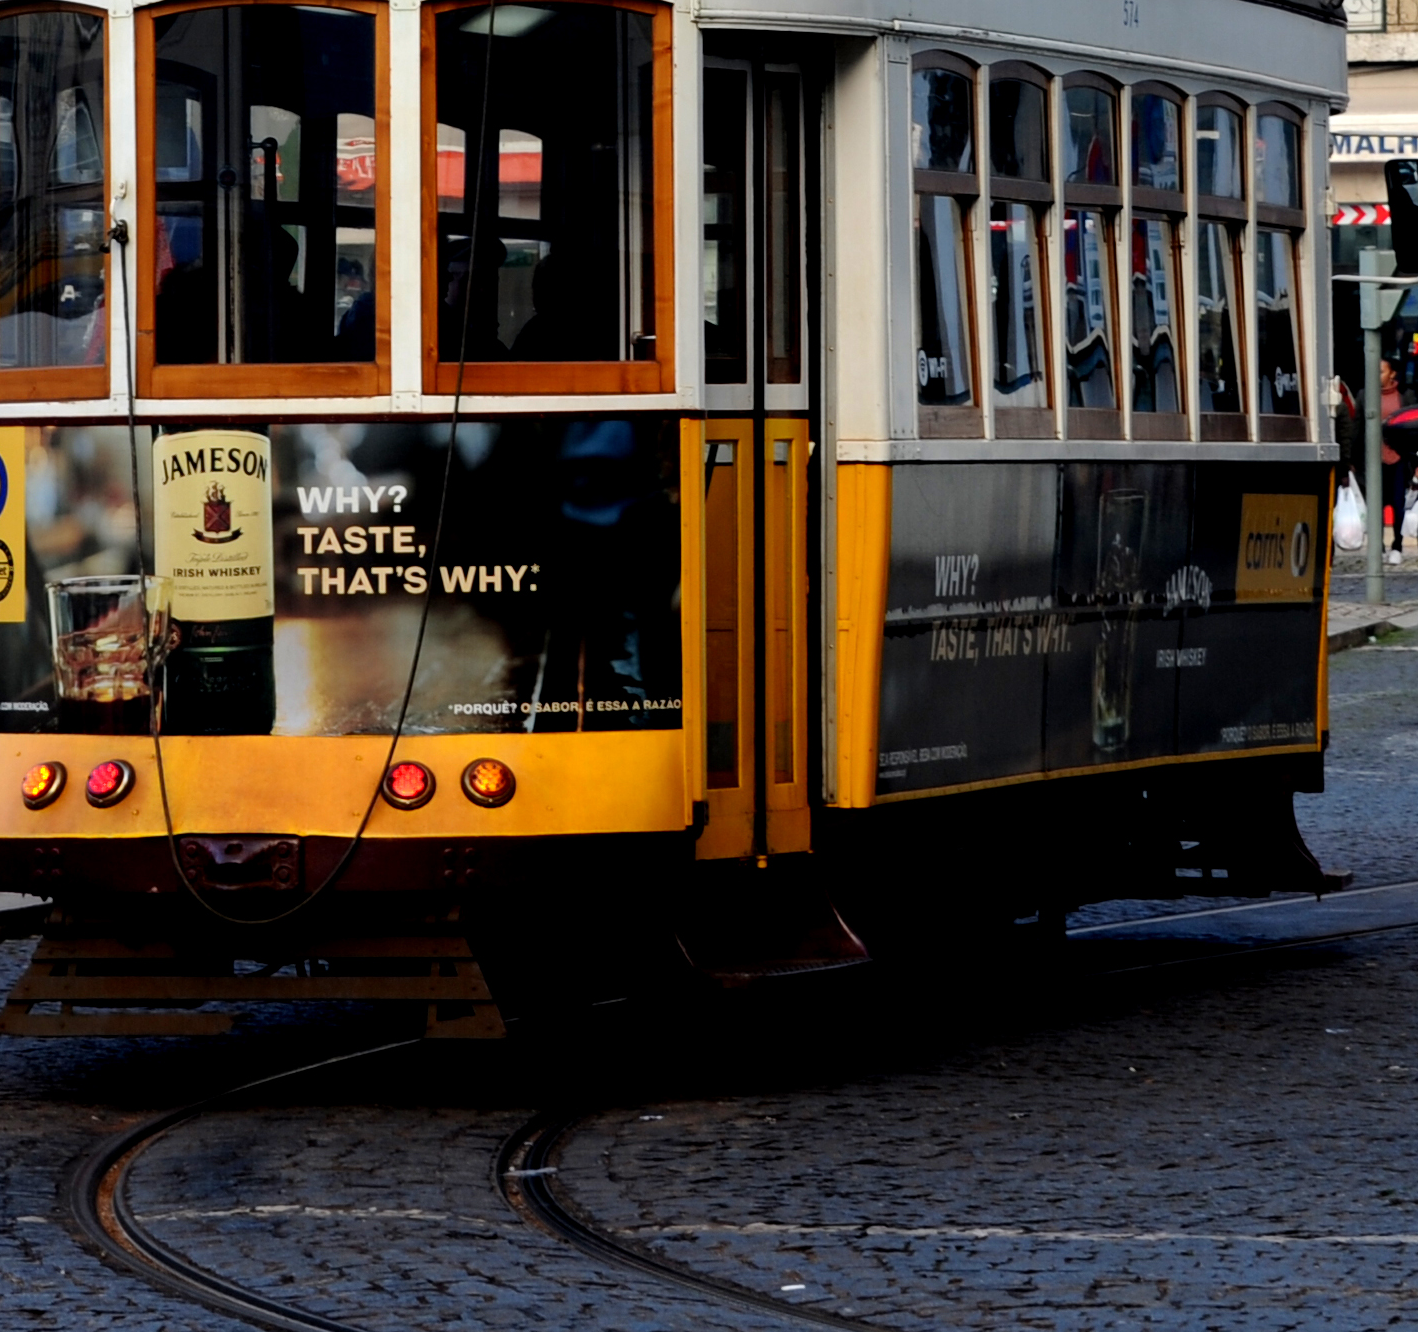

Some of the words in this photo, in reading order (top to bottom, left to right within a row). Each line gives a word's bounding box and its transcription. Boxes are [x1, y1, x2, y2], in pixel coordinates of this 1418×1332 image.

[1123, 0, 1139, 28] 574
[162, 447, 268, 486] JAMESON
[296, 485, 408, 514] WHY?
[296, 525, 427, 558] TASTE,
[173, 568, 204, 578] IRISH
[209, 566, 262, 578] WHISKEY
[296, 565, 428, 595] THAT'S
[935, 553, 980, 597] WHY?
[931, 619, 979, 667] TASTE,
[597, 700, 630, 712] ESSA
[632, 700, 641, 711] A
